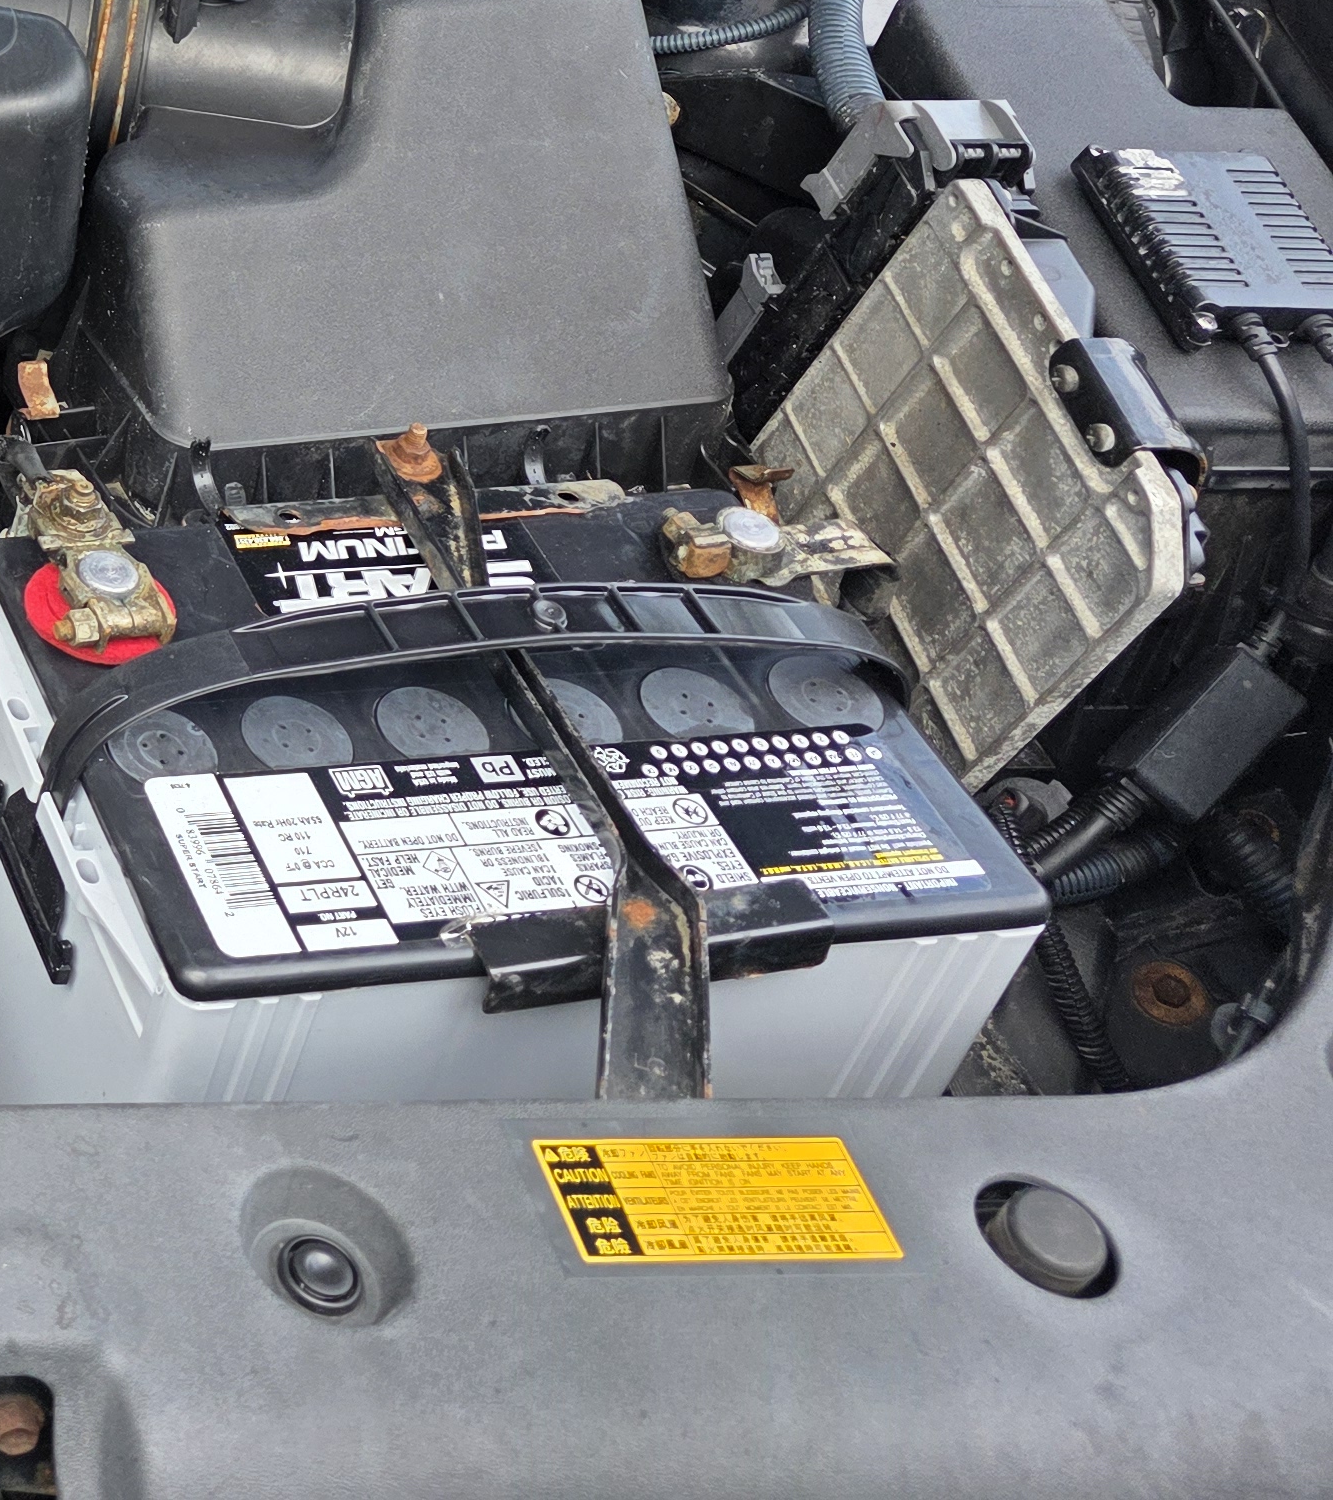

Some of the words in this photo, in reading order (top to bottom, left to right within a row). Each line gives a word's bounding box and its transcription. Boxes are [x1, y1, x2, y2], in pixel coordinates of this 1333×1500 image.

[482, 758, 516, 777] Pb
[332, 768, 386, 792] AGM
[409, 802, 467, 816] DISASSEMBLE
[466, 801, 484, 811] NOT
[641, 806, 669, 816] REACH
[395, 807, 410, 817] OR
[252, 820, 275, 829] Rate
[461, 817, 529, 831] INSTRUCTIONS.
[654, 815, 676, 825] KEEP
[294, 831, 311, 841] 110
[492, 828, 510, 838] ALL
[511, 826, 535, 836] READ
[672, 830, 708, 839] INJURY.
[708, 828, 722, 837] OR
[278, 833, 294, 842] RC
[401, 835, 426, 845] OPEN
[428, 834, 444, 845] NOT
[445, 833, 459, 843] DO
[710, 837, 728, 846] CAN
[358, 838, 400, 849] BATTERY.
[504, 843, 539, 854] SEVERE
[679, 839, 709, 849] CAUSE
[294, 846, 312, 856] 710
[468, 846, 504, 857] BURNS.
[680, 848, 736, 861] EXPLOSIVE
[175, 834, 194, 860] SUPER
[189, 862, 208, 890] START
[361, 856, 391, 867] FAST.
[395, 853, 420, 865] HELP
[479, 858, 494, 868] OR
[495, 853, 545, 865] BLINDNESS
[313, 859, 335, 871] CCA
[533, 864, 552, 874] CAN
[712, 860, 744, 870] EYES.
[934, 865, 950, 875] DO
[367, 865, 416, 878] MEDICAL
[501, 866, 532, 877] CAUSE
[862, 871, 874, 880] TO
[877, 868, 915, 879] ATTEMPT
[915, 867, 934, 876] NOT
[532, 875, 554, 886] ACID
[715, 872, 753, 883] SHIELD
[836, 873, 862, 883] OPEN
[375, 879, 396, 890] GET
[441, 882, 470, 894] WITH
[903, 878, 958, 890] IMPORTANT
[298, 885, 360, 902] 24RPLT
[399, 885, 440, 897] WATER.
[514, 887, 564, 900] SULFURIC
[406, 893, 476, 908] IMMEDIATELY
[420, 907, 448, 918] EYES
[449, 904, 480, 918] FLUSH
[335, 926, 357, 938] 12V
[553, 1167, 610, 1183] CAUTION
[566, 1194, 621, 1209] ATTENTION
